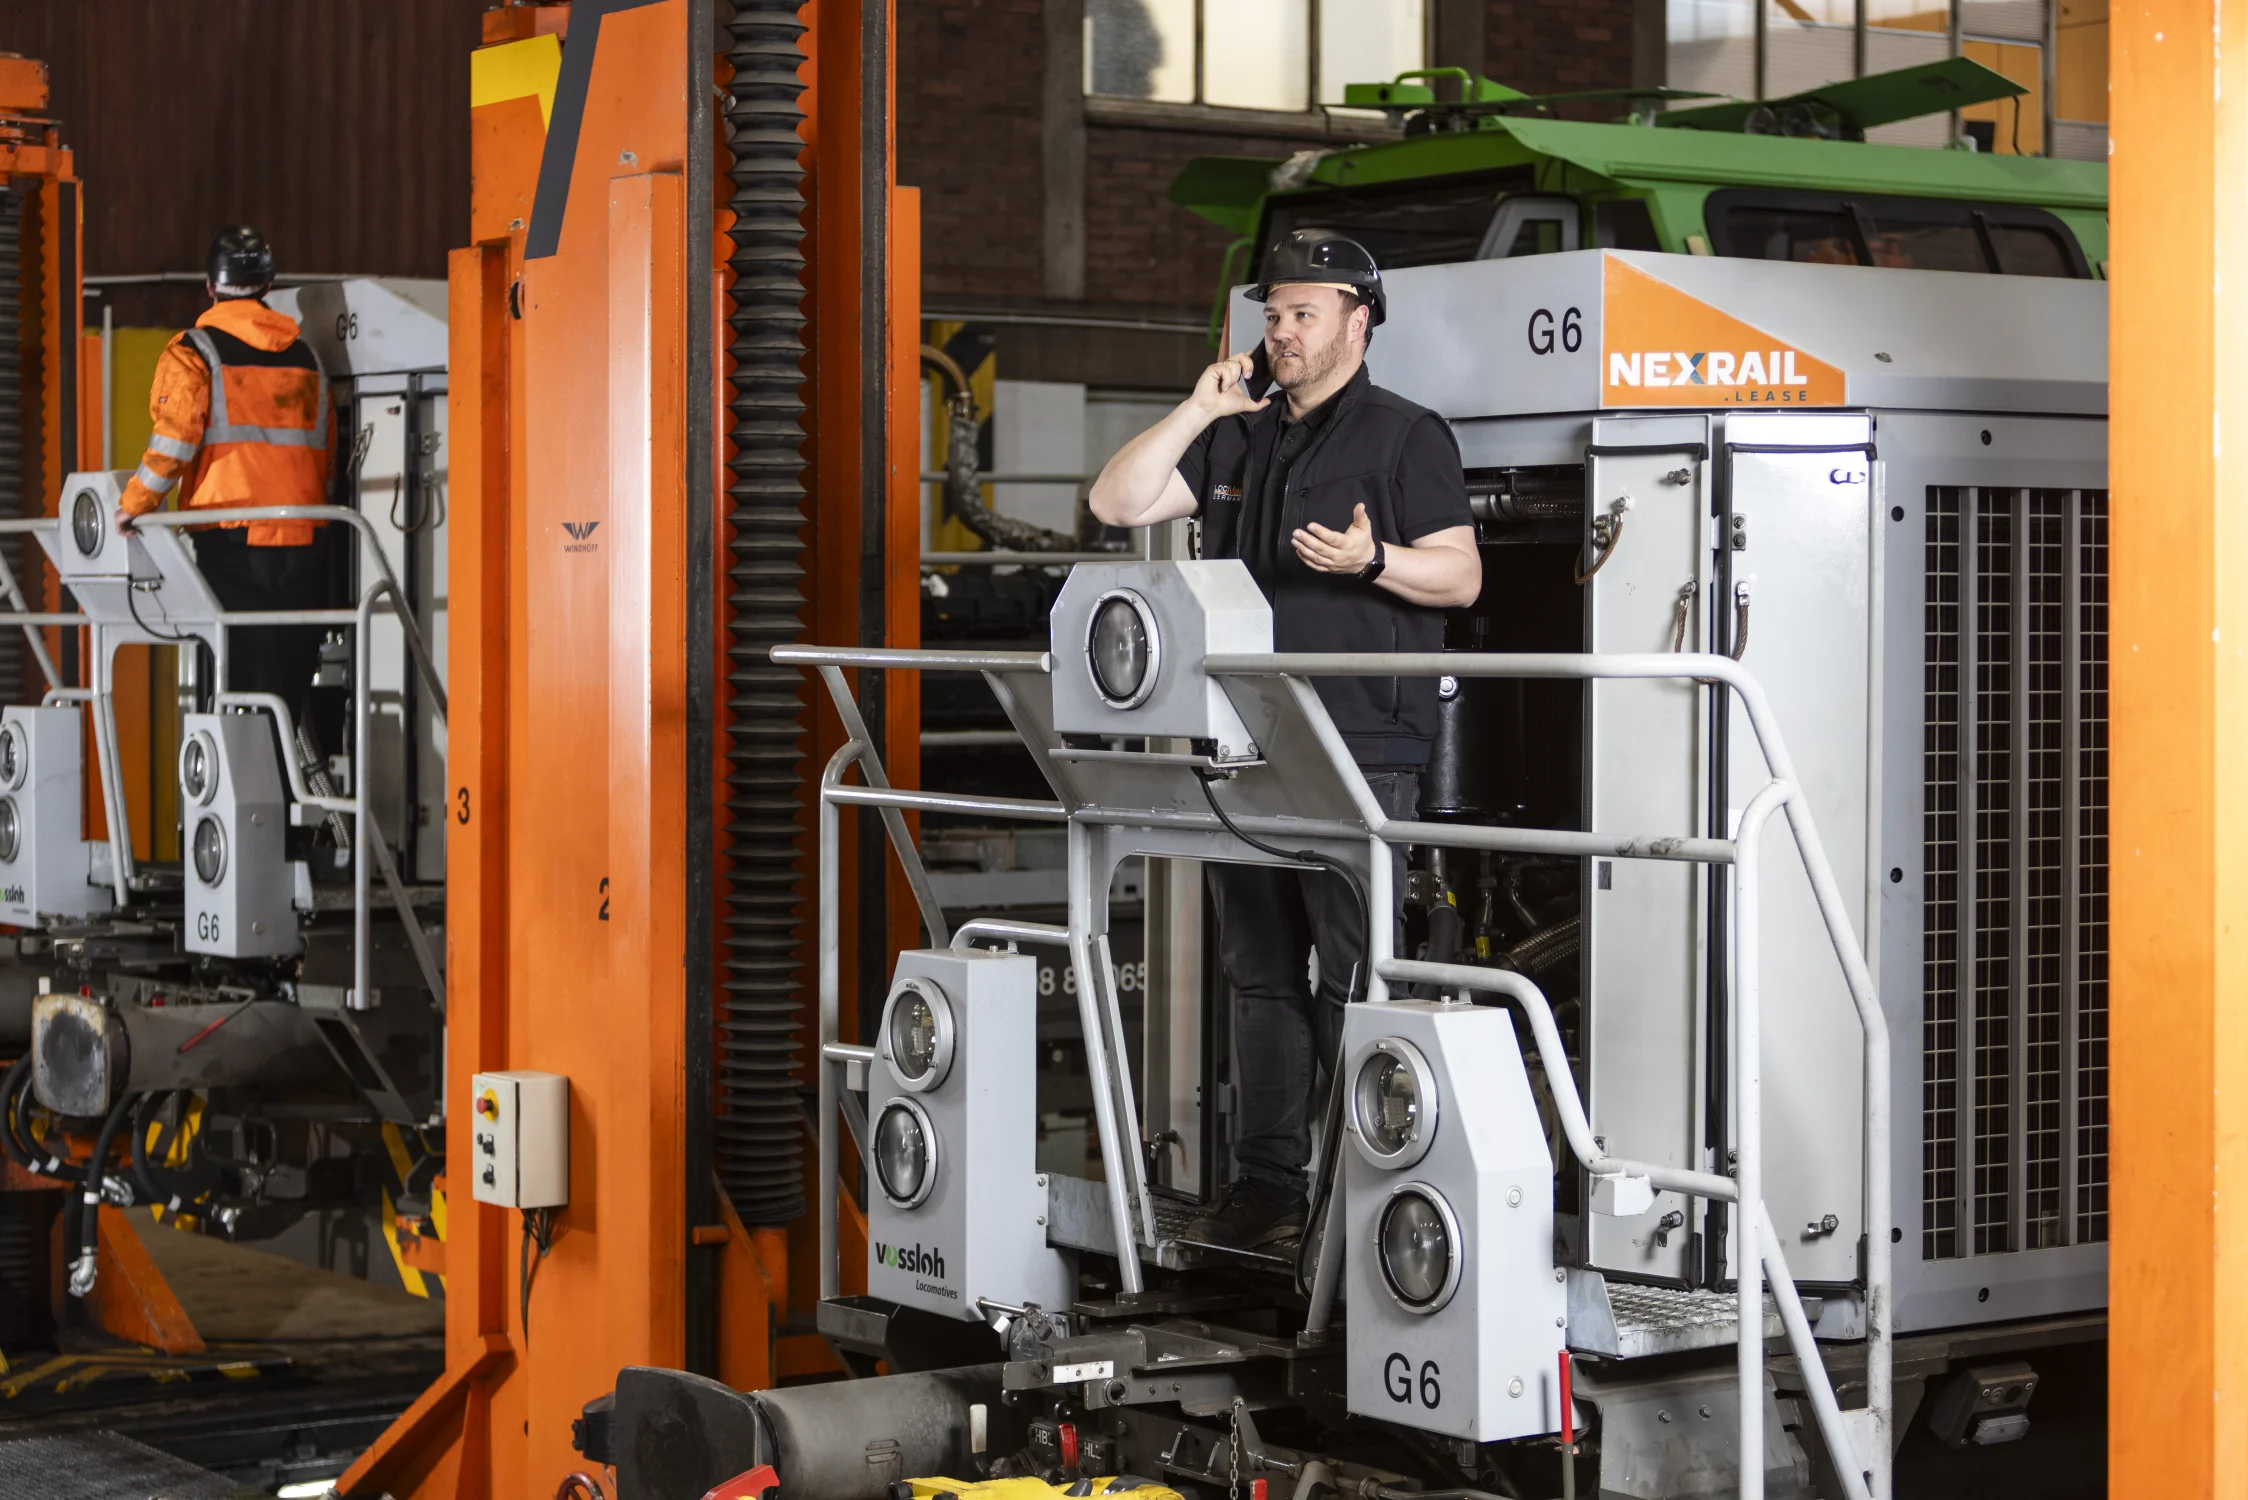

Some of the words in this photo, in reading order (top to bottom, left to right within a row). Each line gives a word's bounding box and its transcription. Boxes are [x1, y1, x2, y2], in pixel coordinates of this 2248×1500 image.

[336, 313, 358, 341] G6
[1528, 307, 1582, 355] G6
[1610, 351, 1807, 387] NEXRAIL
[564, 544, 598, 553] WINDHOFF
[457, 787, 470, 825] 3
[198, 911, 219, 942] G6
[875, 1242, 945, 1279] vossloh
[916, 1279, 957, 1299] Locomotives
[1384, 1352, 1440, 1409] G6
